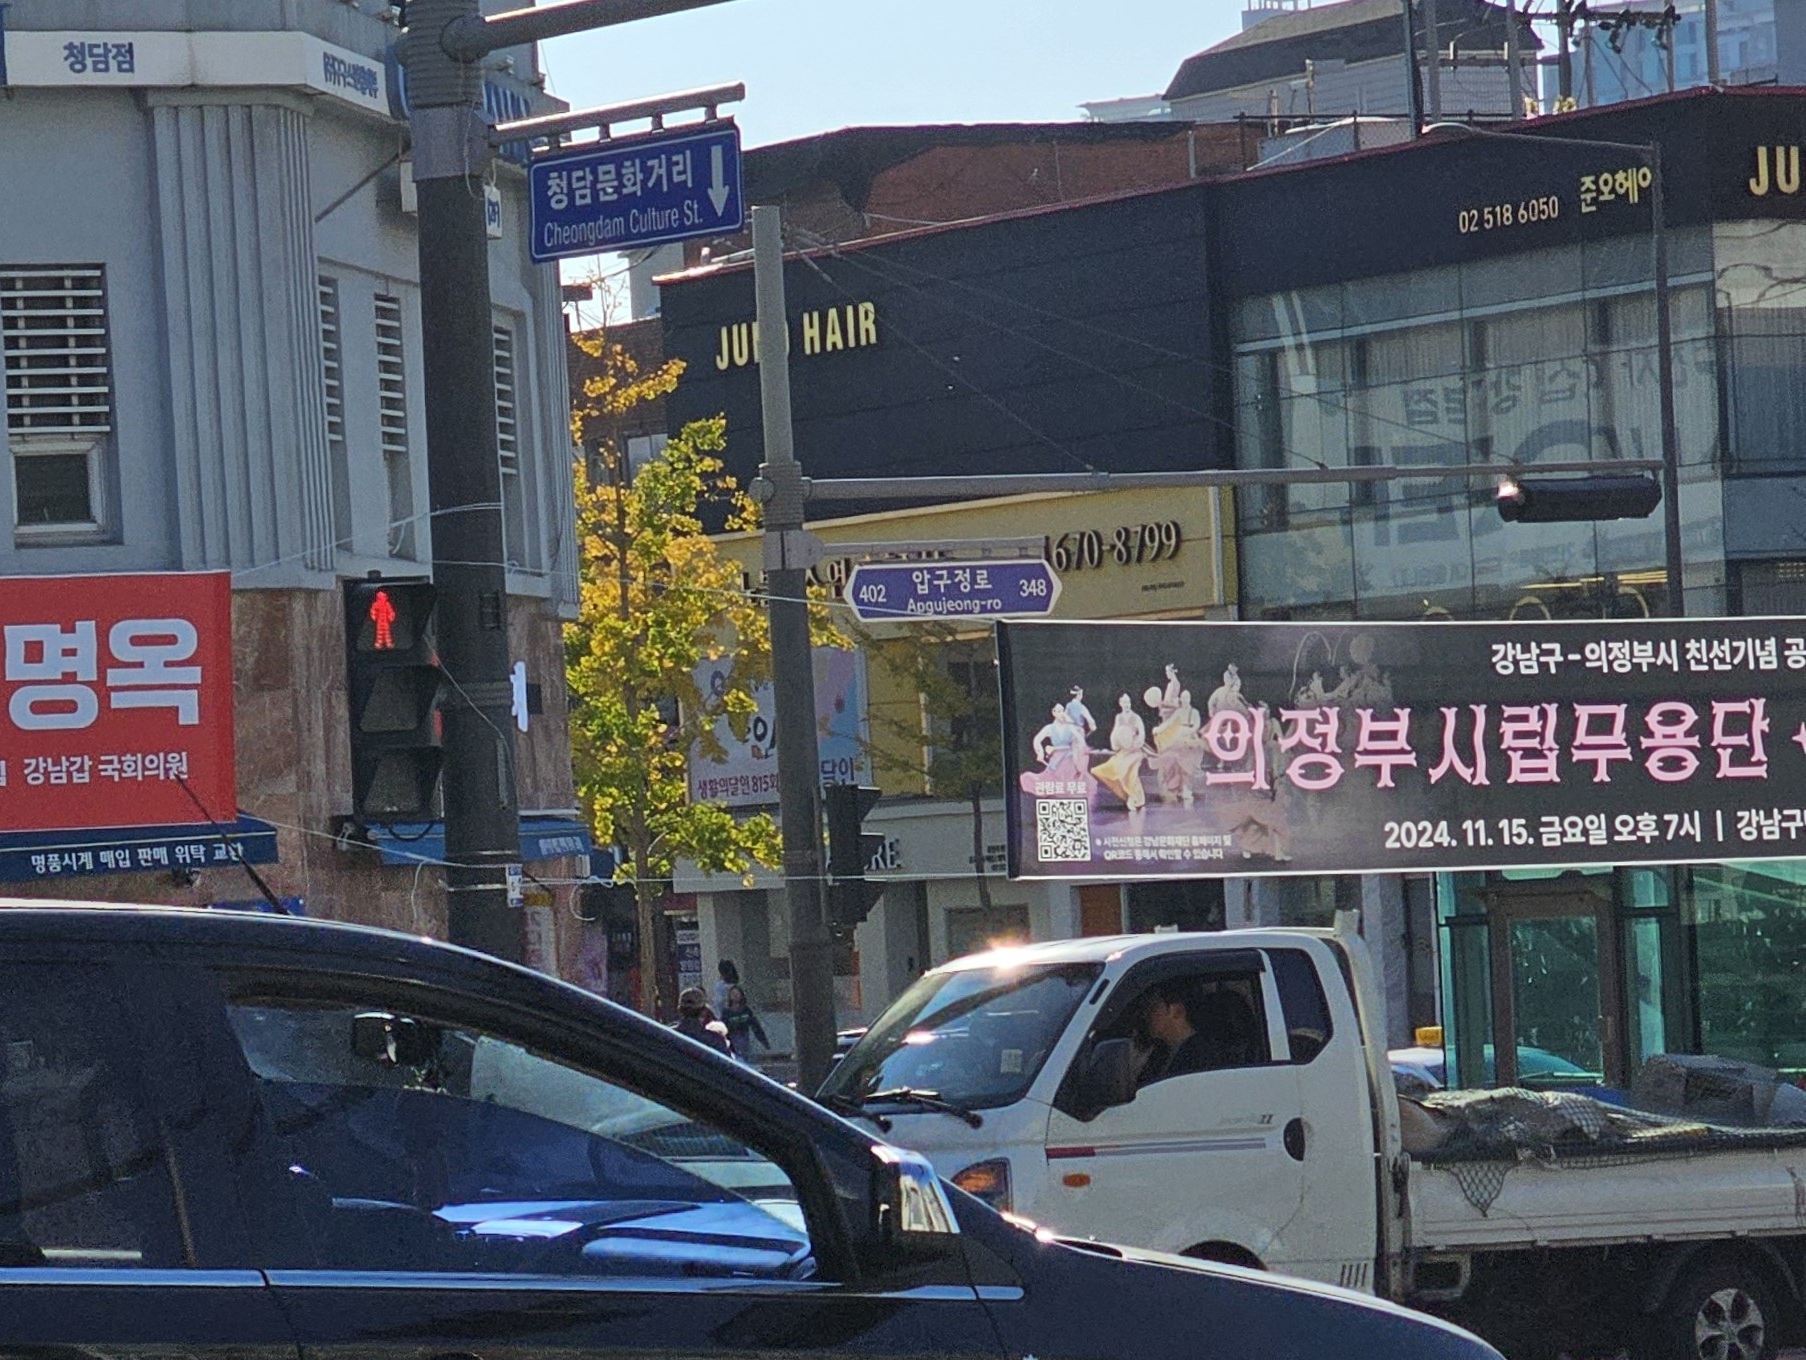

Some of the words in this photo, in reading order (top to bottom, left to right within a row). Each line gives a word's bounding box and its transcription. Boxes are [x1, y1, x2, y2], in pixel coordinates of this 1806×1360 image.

[62, 41, 135, 75] 청담점
[546, 150, 693, 211] 청담문화거리
[544, 206, 626, 248] Cheongdam
[628, 202, 681, 241] Culture
[682, 199, 704, 226] St.
[1458, 210, 1480, 234] 02
[1483, 203, 1514, 229] 518
[1517, 195, 1560, 222] 6050
[715, 321, 790, 371] JU
[802, 301, 878, 356] HAIR
[858, 584, 887, 604] 402
[911, 569, 993, 595] 압구정로
[1018, 578, 1047, 598] 348
[906, 597, 1002, 616] Apgujeong-ro
[1685, 636, 1778, 671] 친선기념
[1202, 697, 1771, 791] 의정부시립무용단
[23, 754, 93, 786] 강남갑
[97, 751, 188, 781] 국회의원
[1384, 820, 1457, 849] 2024.
[1461, 819, 1494, 847] 11.
[1497, 818, 1535, 846] 15.
[1539, 813, 1608, 848] 금요일
[1613, 813, 1660, 844] 오후
[1663, 809, 1701, 843] 7시
[1736, 807, 1806, 842] 강남구
[136, 846, 169, 867] 판매
[174, 844, 207, 865] 위탁
